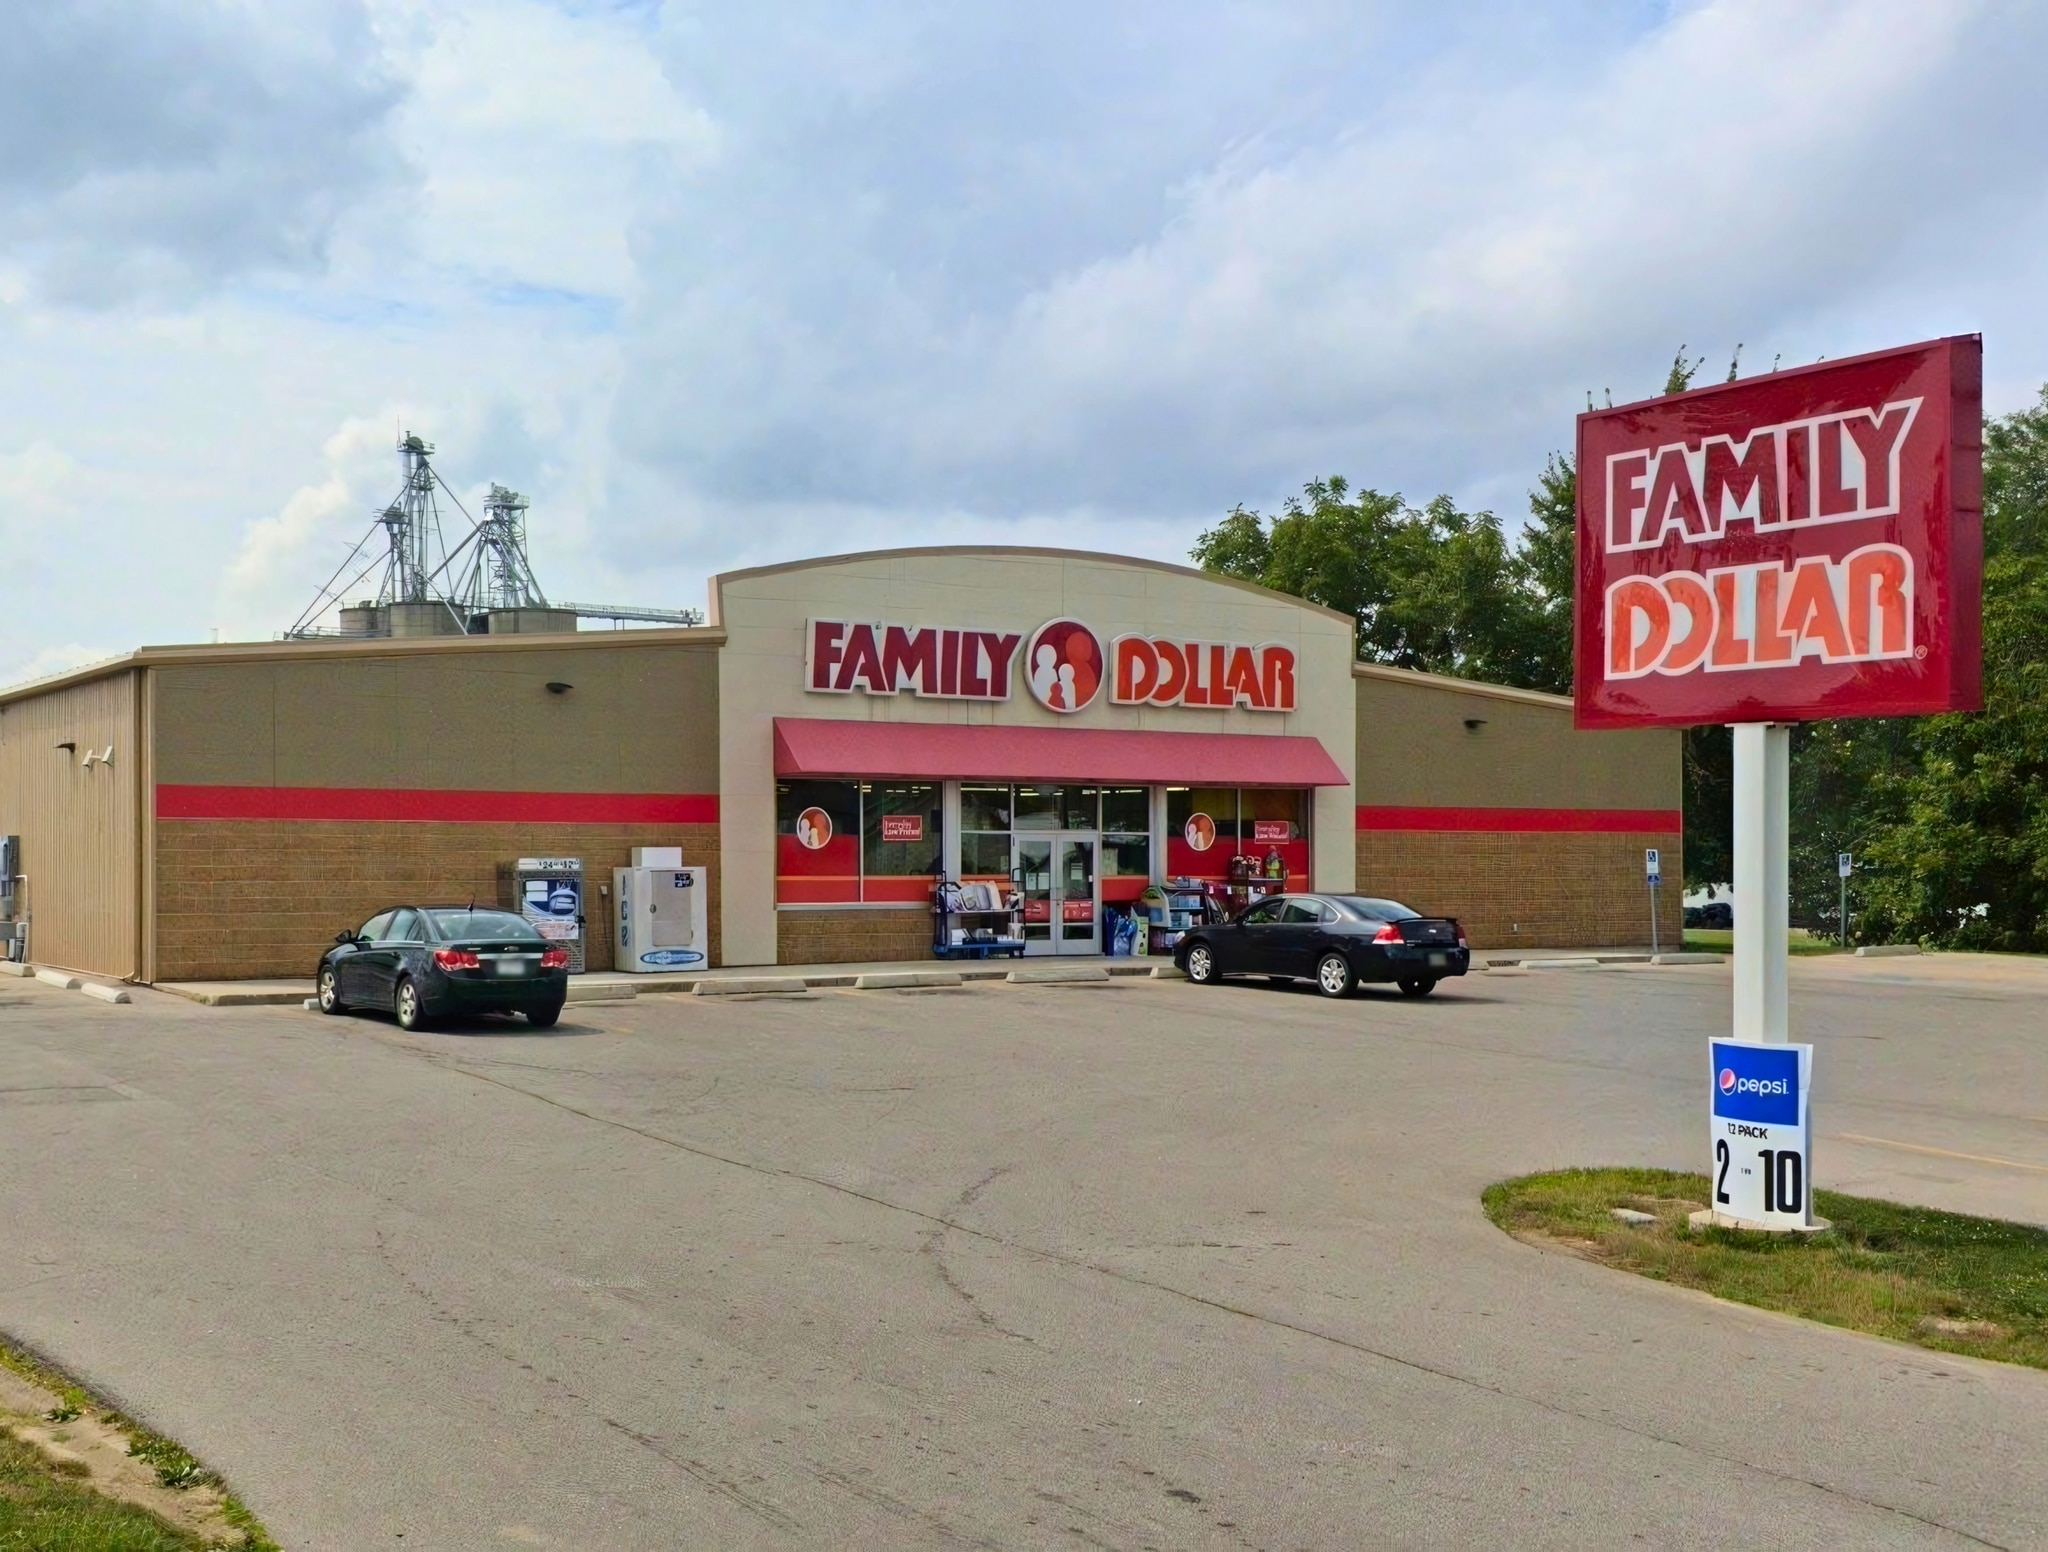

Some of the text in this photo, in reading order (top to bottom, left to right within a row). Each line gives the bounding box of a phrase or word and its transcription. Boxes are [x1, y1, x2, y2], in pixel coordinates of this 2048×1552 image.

[1609, 400, 1919, 550] FAMILY
[1608, 545, 1911, 676] DOLLAR
[811, 620, 1296, 711] FAMILY DOLLAR
[1737, 1078, 1788, 1097] pepsi
[1738, 1124, 1768, 1140] PACK
[1716, 1138, 1802, 1214] 2 10
